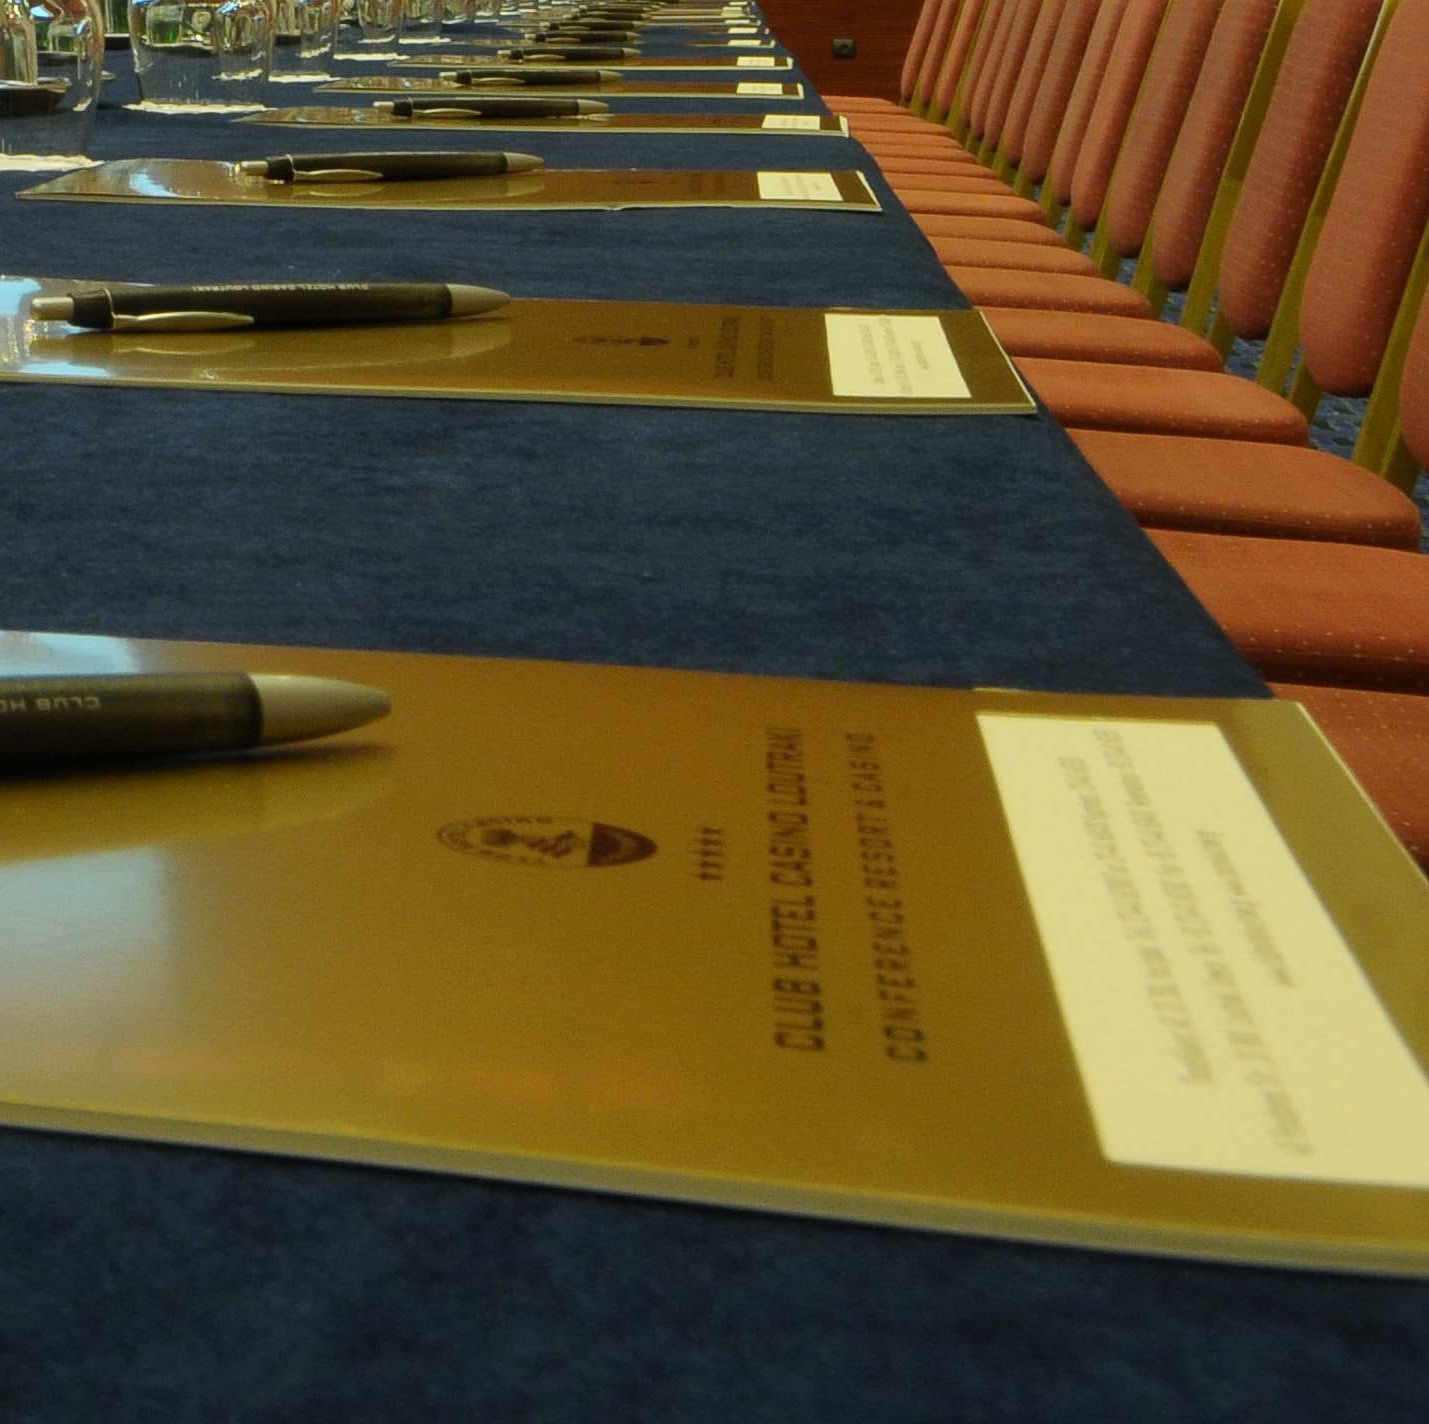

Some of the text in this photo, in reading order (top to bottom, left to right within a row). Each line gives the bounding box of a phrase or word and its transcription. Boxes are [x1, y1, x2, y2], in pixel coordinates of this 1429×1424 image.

[36, 694, 100, 712] CLUB
[768, 810, 814, 887] CASINO
[769, 895, 820, 970] HOTEL
[773, 978, 827, 1053] CLUB
